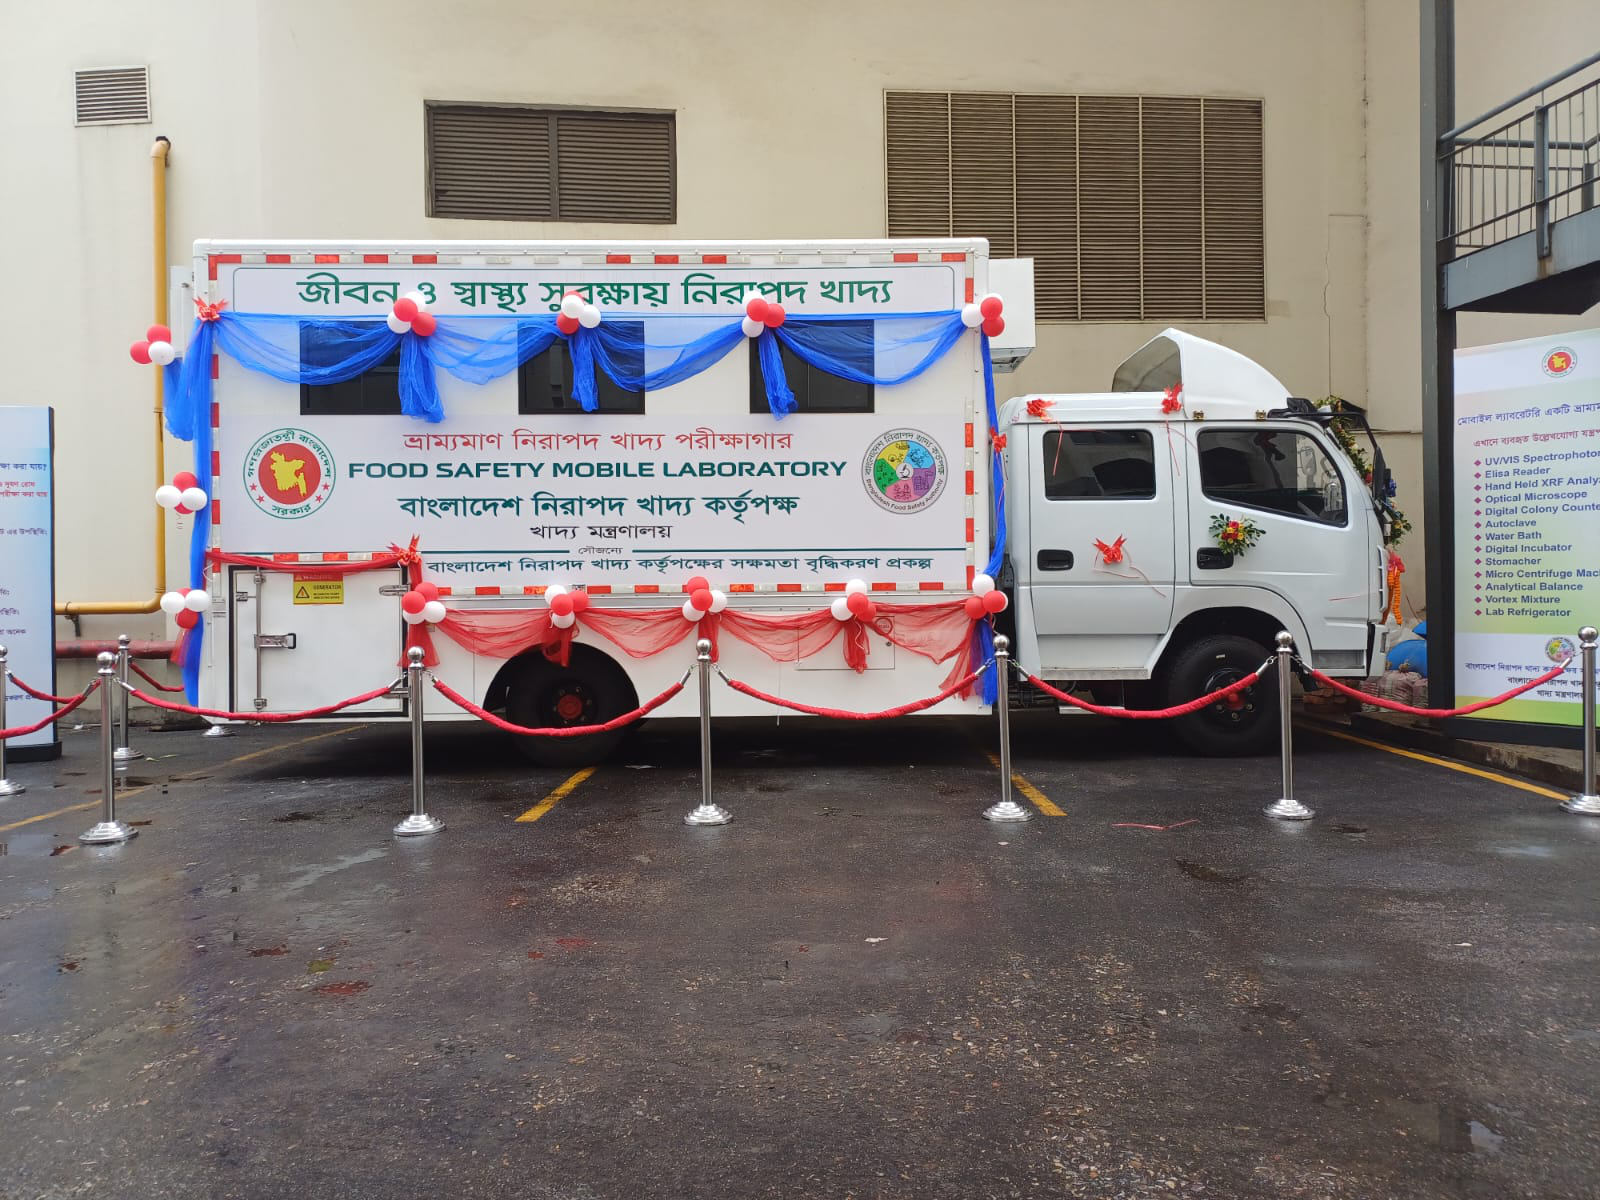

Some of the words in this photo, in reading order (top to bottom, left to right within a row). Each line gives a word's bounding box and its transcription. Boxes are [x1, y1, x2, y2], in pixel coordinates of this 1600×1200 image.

[296, 272, 400, 304] জীবন
[450, 282, 528, 312] স্বাস্থ্য
[820, 281, 894, 303] খাদ্য
[1458, 414, 1492, 426] মোবাইল
[1495, 407, 1541, 421] ল্যাবরেটরি
[1545, 403, 1570, 416] একটি
[402, 433, 504, 451] ভ্রাম্যমাণ
[511, 428, 602, 451] নিরাপদ
[610, 431, 666, 451] খাদ্য
[675, 427, 793, 450] পরীক্ষাগার
[1474, 437, 1498, 447] এখানে
[299, 434, 331, 478] বাংলাদেশ
[1485, 455, 1520, 466] UV/VIS
[348, 463, 429, 478] FOOD
[436, 463, 545, 478] SAFETY
[552, 462, 655, 478] MOBILE
[663, 461, 848, 478] LABORATORY
[1485, 470, 1510, 479] Elisa
[1513, 467, 1551, 477] Reader
[1485, 482, 1511, 491] Hand
[1515, 480, 1538, 489] Held
[1542, 478, 1563, 487] XRF
[1485, 493, 1521, 504] Optical
[1524, 491, 1587, 502] Microscope
[272, 504, 311, 516] সরকার
[397, 496, 524, 518] বাংলাদেশ
[531, 491, 628, 517] নিরাপদ
[636, 495, 695, 516] খাদ্য
[702, 489, 801, 524] কর্তৃপক্ষ
[890, 503, 906, 511] Food
[1485, 507, 1518, 517] Digital
[1521, 504, 1558, 515] Colony
[1485, 519, 1537, 528] Autoclave
[530, 525, 579, 540] খাদ্য
[588, 525, 673, 540] মন্ত্রণালয়
[1485, 532, 1515, 541] Water
[1517, 531, 1542, 540] Bath
[578, 546, 623, 555] সৌজন্যে
[1485, 545, 1518, 555] Digital
[1521, 543, 1572, 552] Incubator
[428, 559, 512, 574] বাংলাদেশ
[520, 557, 585, 573] নিরাপদ
[591, 558, 632, 572] খাদ্য
[637, 555, 725, 576] কর্তৃপক্ষের
[730, 557, 800, 570] সক্ষমতা
[805, 555, 881, 574] বৃদ্ধিকরণ
[886, 557, 934, 569] প্রকল্প
[1485, 557, 1541, 566] Stomacher
[1485, 570, 1514, 578] Micro
[1517, 569, 1573, 579] Centrifuge
[1576, 569, 1600, 577] Mac
[1485, 583, 1536, 592] Analytical
[1539, 582, 1583, 591] Balance
[1485, 595, 1518, 604] Vortex
[1521, 595, 1560, 604] Mixture
[1485, 608, 1504, 617] Lab
[1507, 608, 1572, 618] Refrigerator
